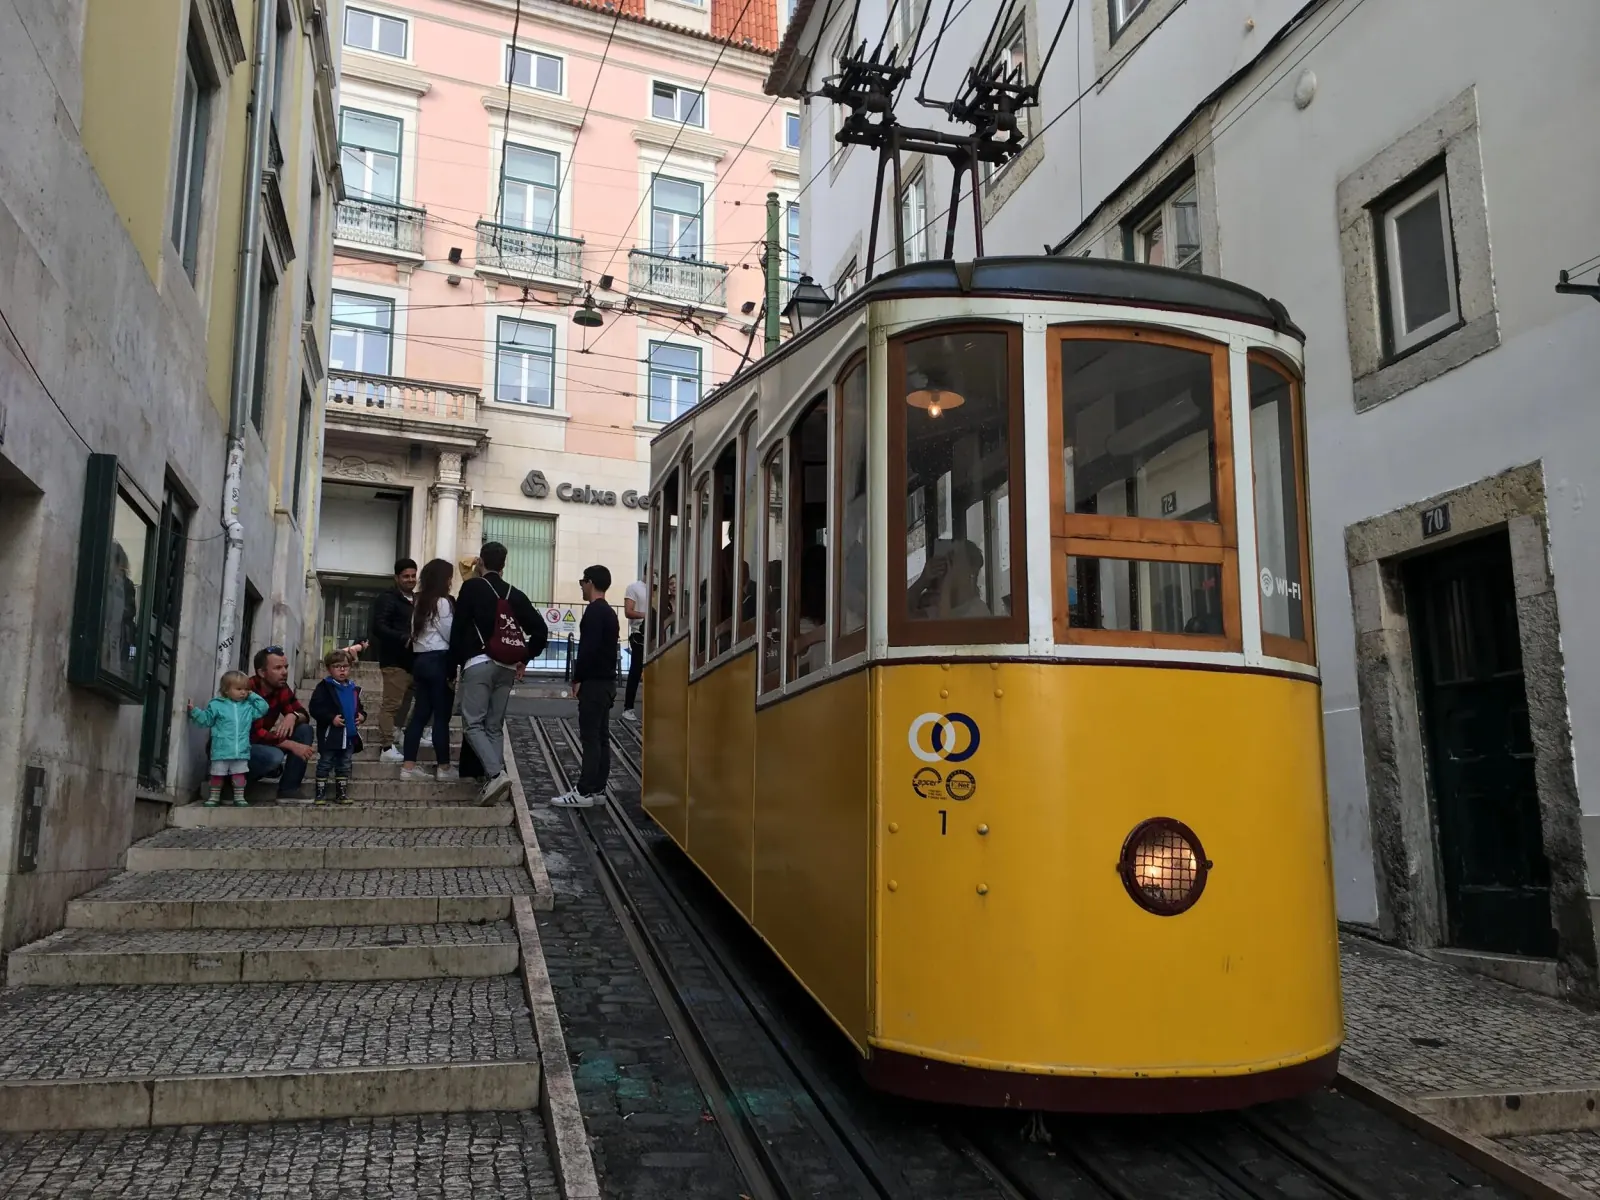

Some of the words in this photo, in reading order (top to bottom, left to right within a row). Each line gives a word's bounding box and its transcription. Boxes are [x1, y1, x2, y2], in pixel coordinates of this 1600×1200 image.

[556, 482, 617, 506] Caixa
[1163, 494, 1174, 512] 72
[1425, 508, 1444, 533] 70
[1275, 576, 1301, 600] WI-FI
[938, 809, 947, 835] 1
